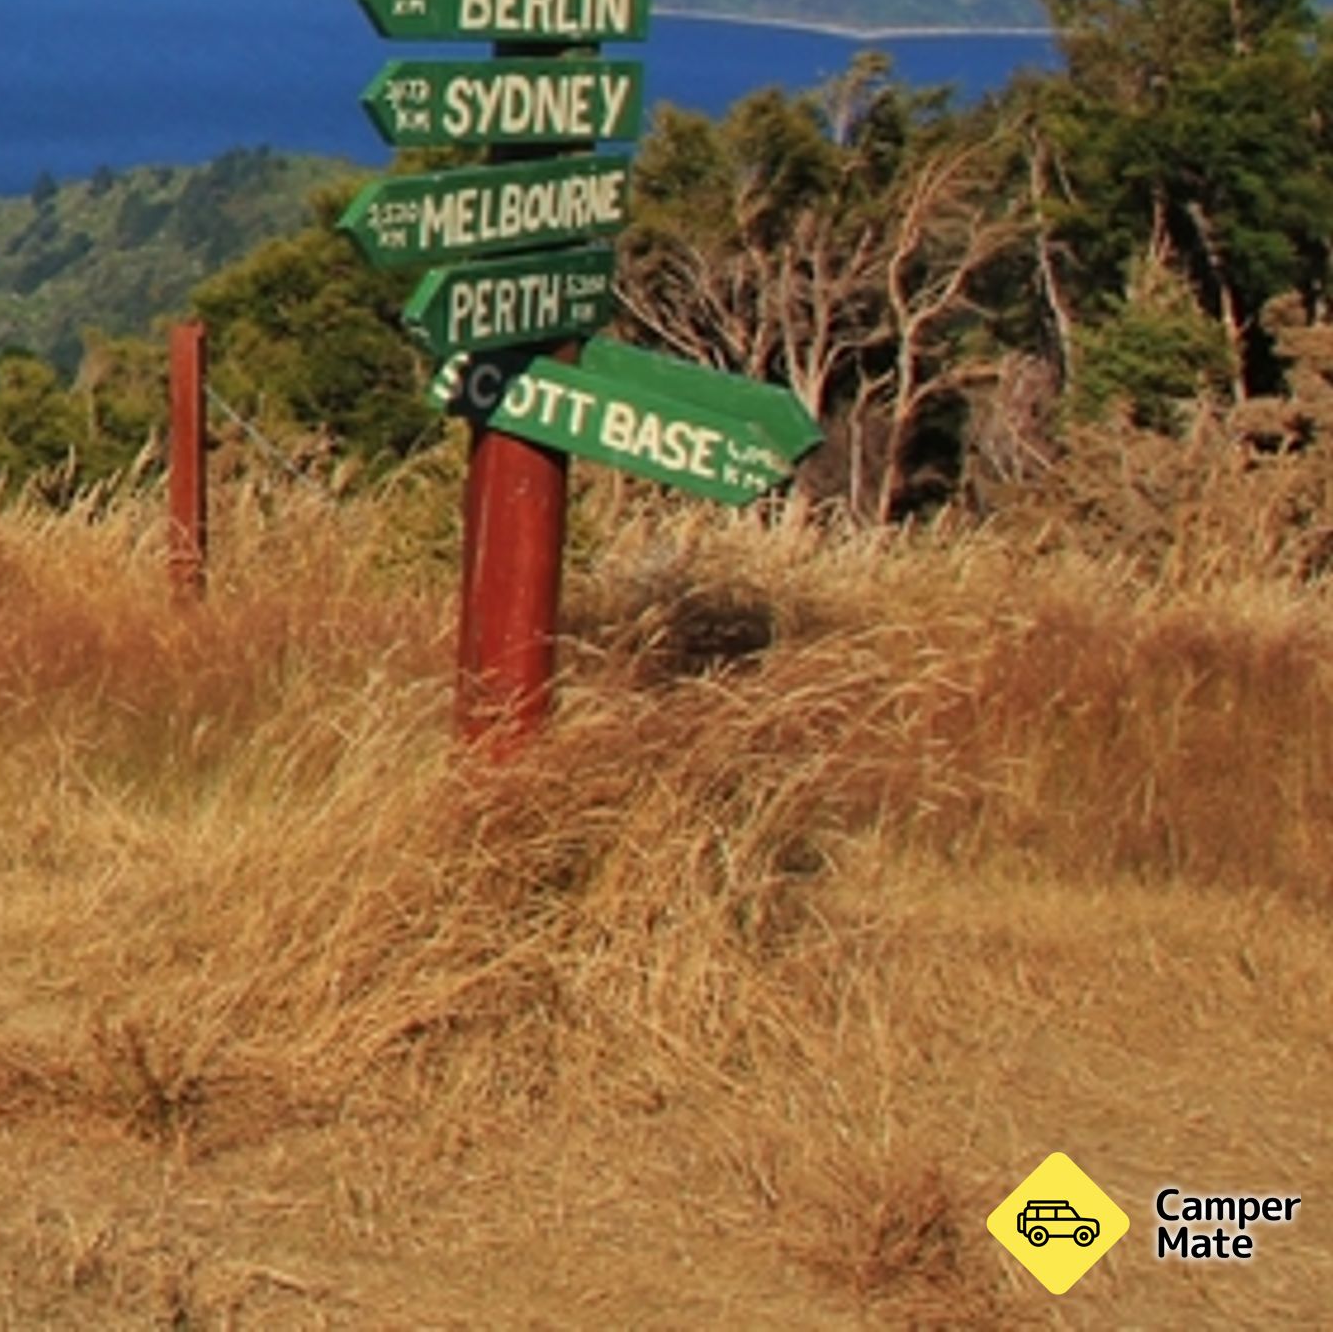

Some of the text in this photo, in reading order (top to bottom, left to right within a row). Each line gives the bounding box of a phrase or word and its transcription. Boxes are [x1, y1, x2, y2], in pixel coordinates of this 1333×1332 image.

[442, 74, 630, 137] SYDNEY
[419, 170, 626, 250] MELBOURNE
[447, 272, 559, 342] PERTH
[433, 351, 596, 436] SCOTT
[599, 402, 723, 481] BASE
